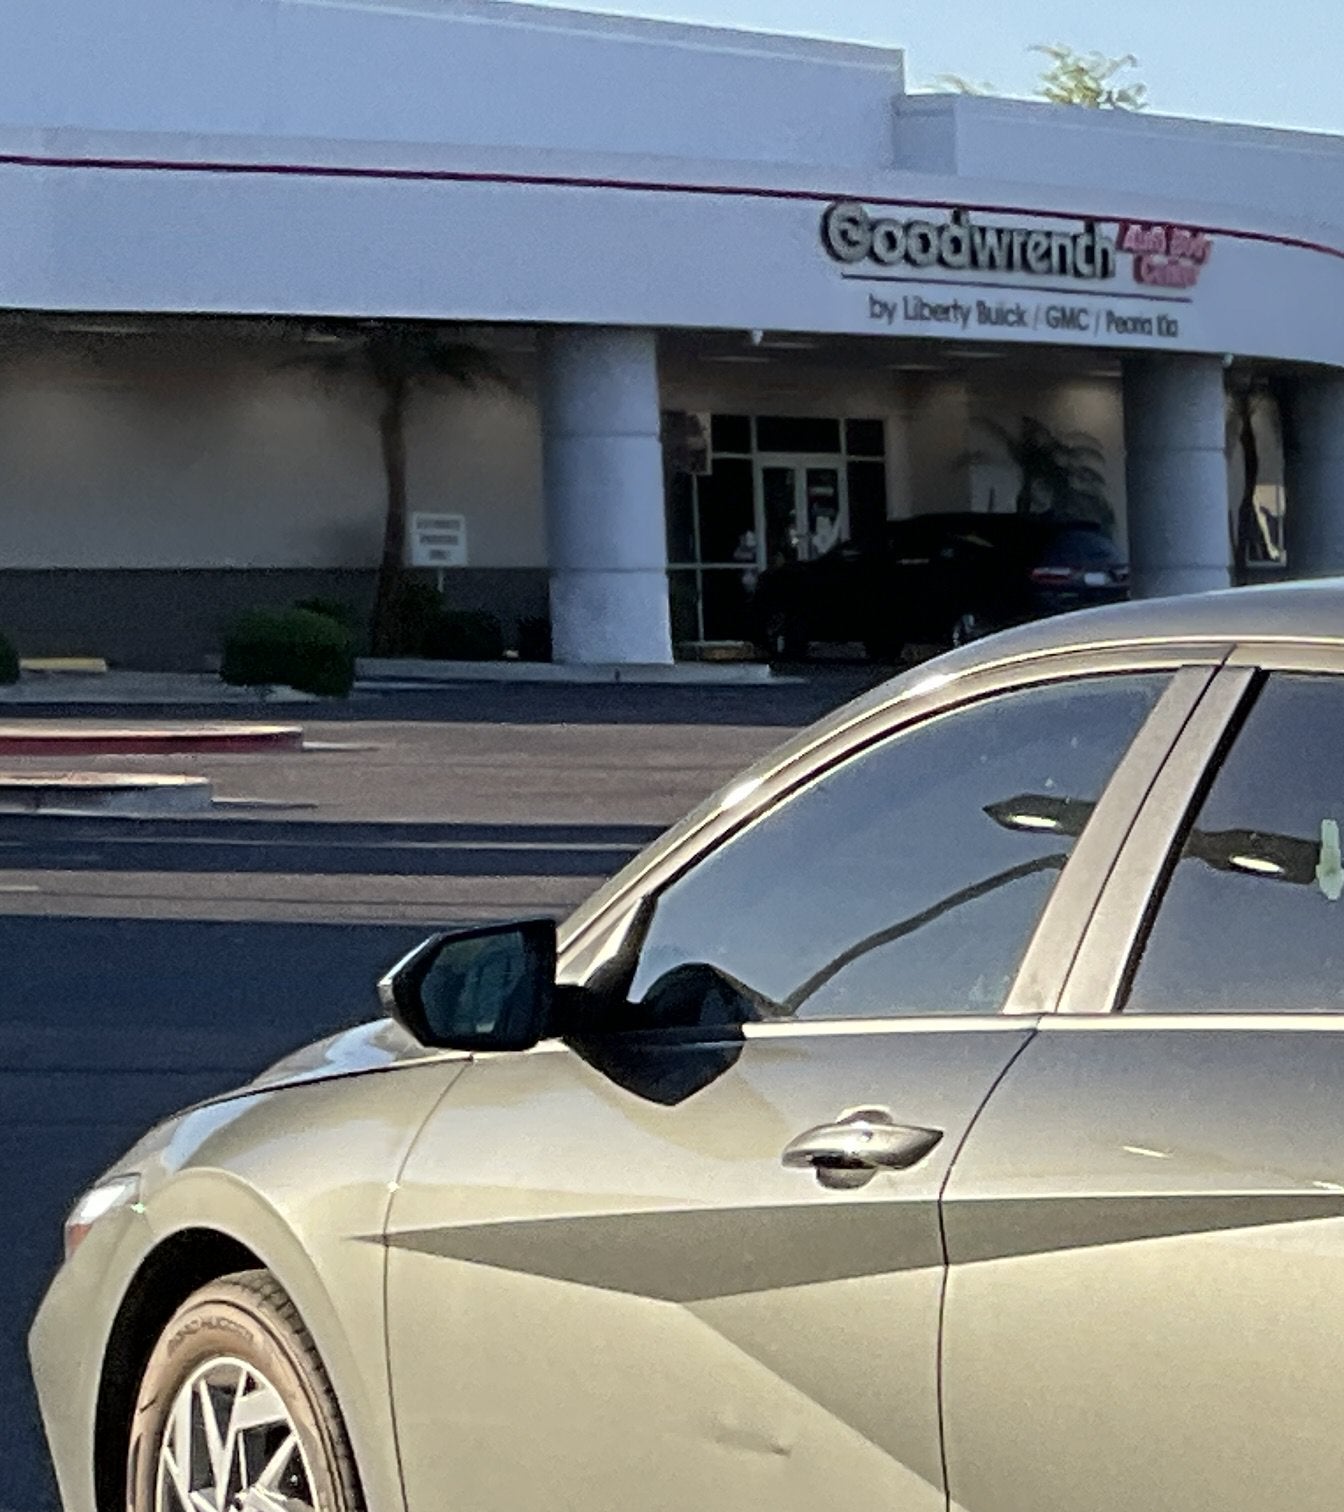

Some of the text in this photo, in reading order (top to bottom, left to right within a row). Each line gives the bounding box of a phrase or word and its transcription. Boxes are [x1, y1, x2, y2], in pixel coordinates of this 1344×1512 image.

[820, 199, 1116, 280] Goodwrench
[868, 292, 898, 326] by
[902, 295, 972, 330] Liberty
[976, 299, 1028, 328] Buick
[1045, 305, 1090, 332] GMC
